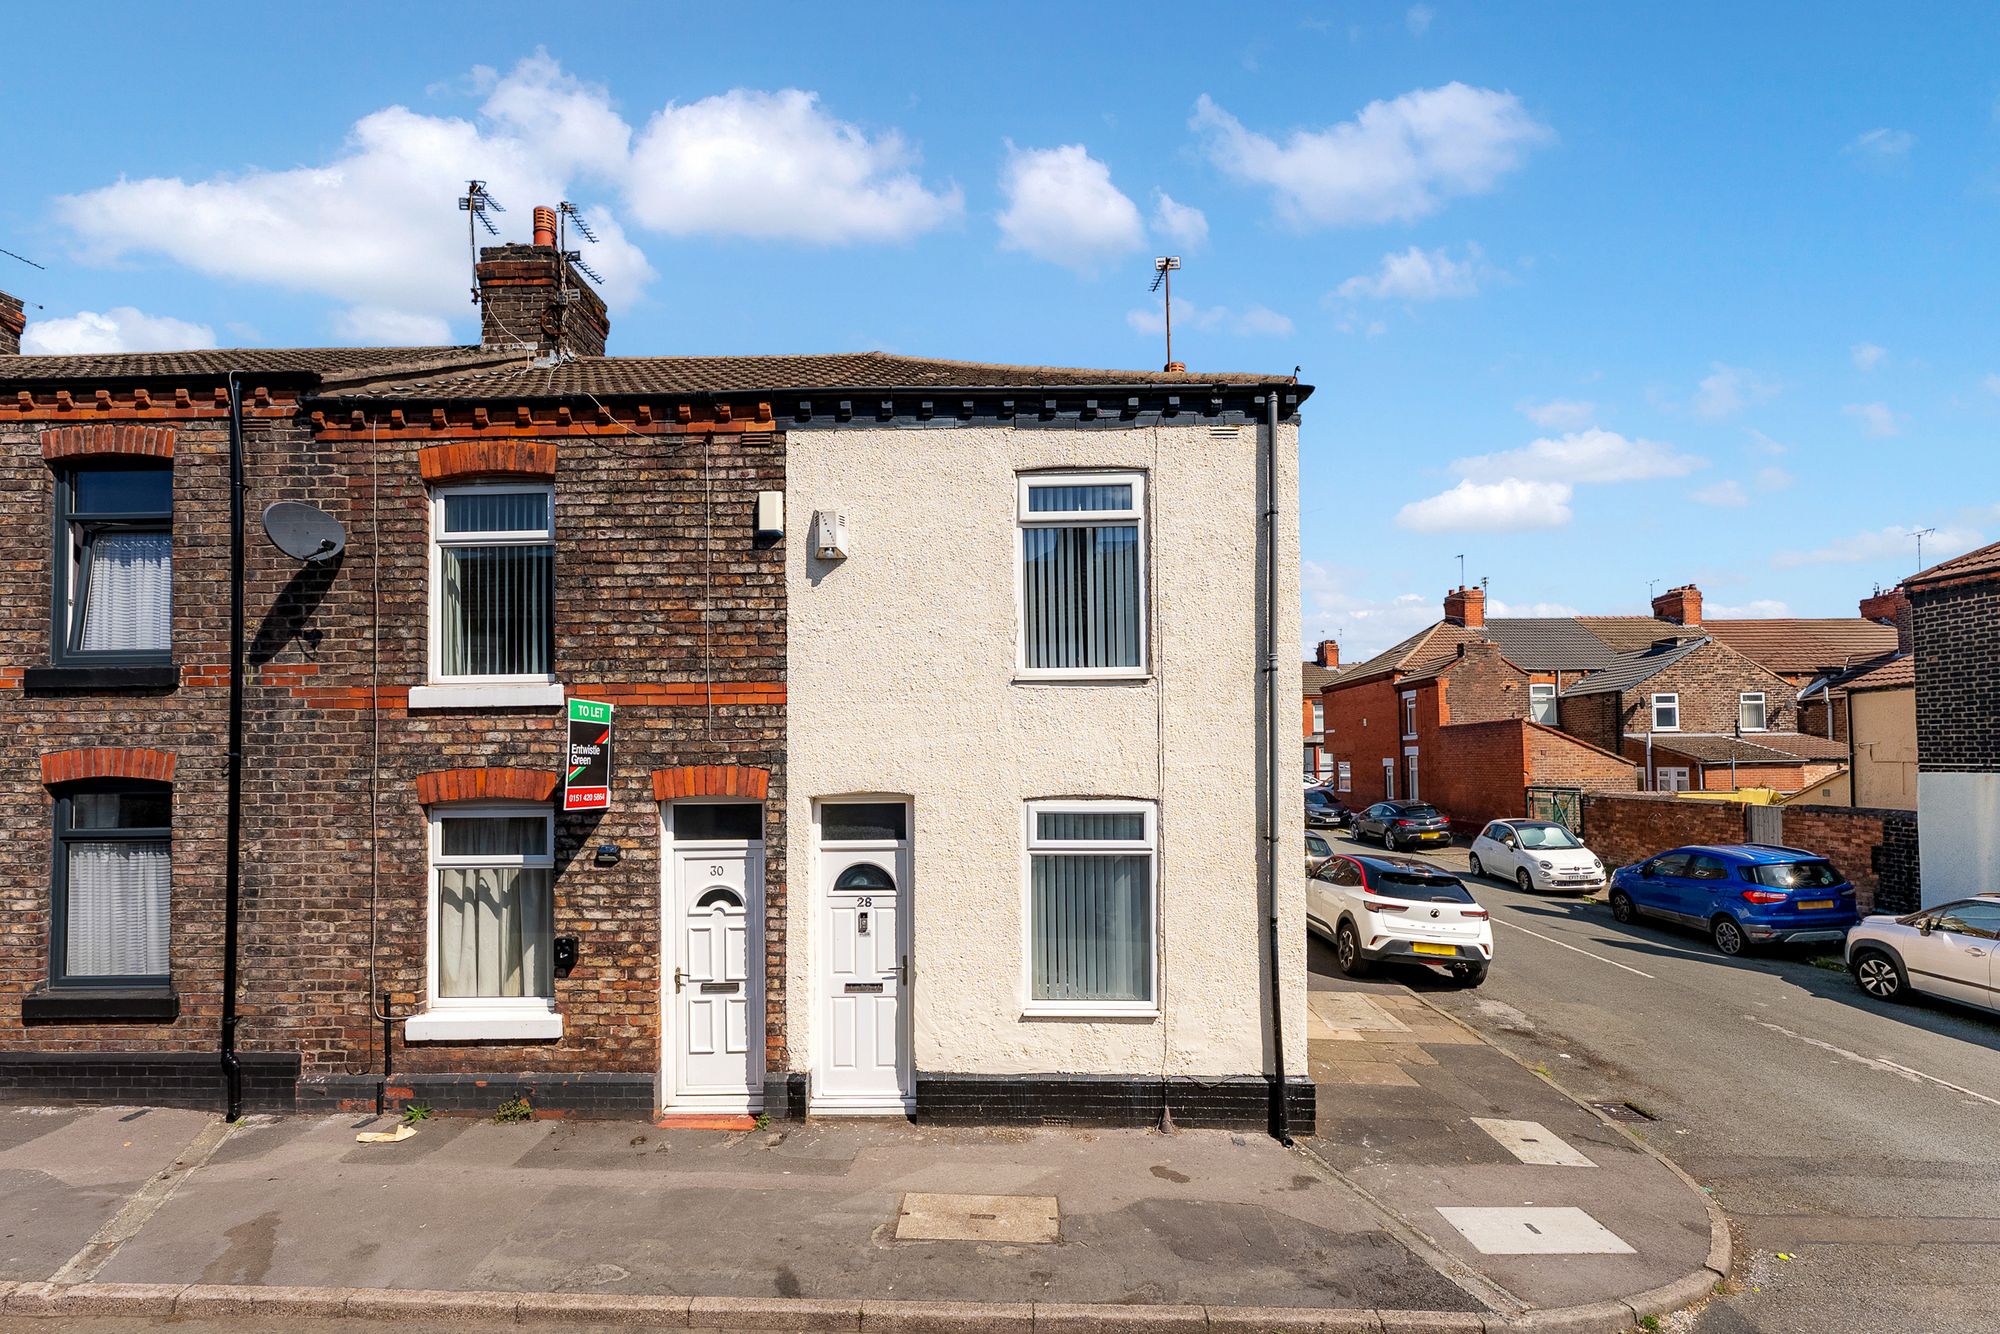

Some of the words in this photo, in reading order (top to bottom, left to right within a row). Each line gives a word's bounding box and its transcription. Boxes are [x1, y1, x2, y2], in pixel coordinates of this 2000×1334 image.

[578, 705, 589, 716] TO
[590, 706, 604, 718] LET
[571, 744, 600, 755] Entwistle
[571, 754, 591, 764] Green
[710, 865, 724, 876] 30
[857, 896, 872, 907] 28
